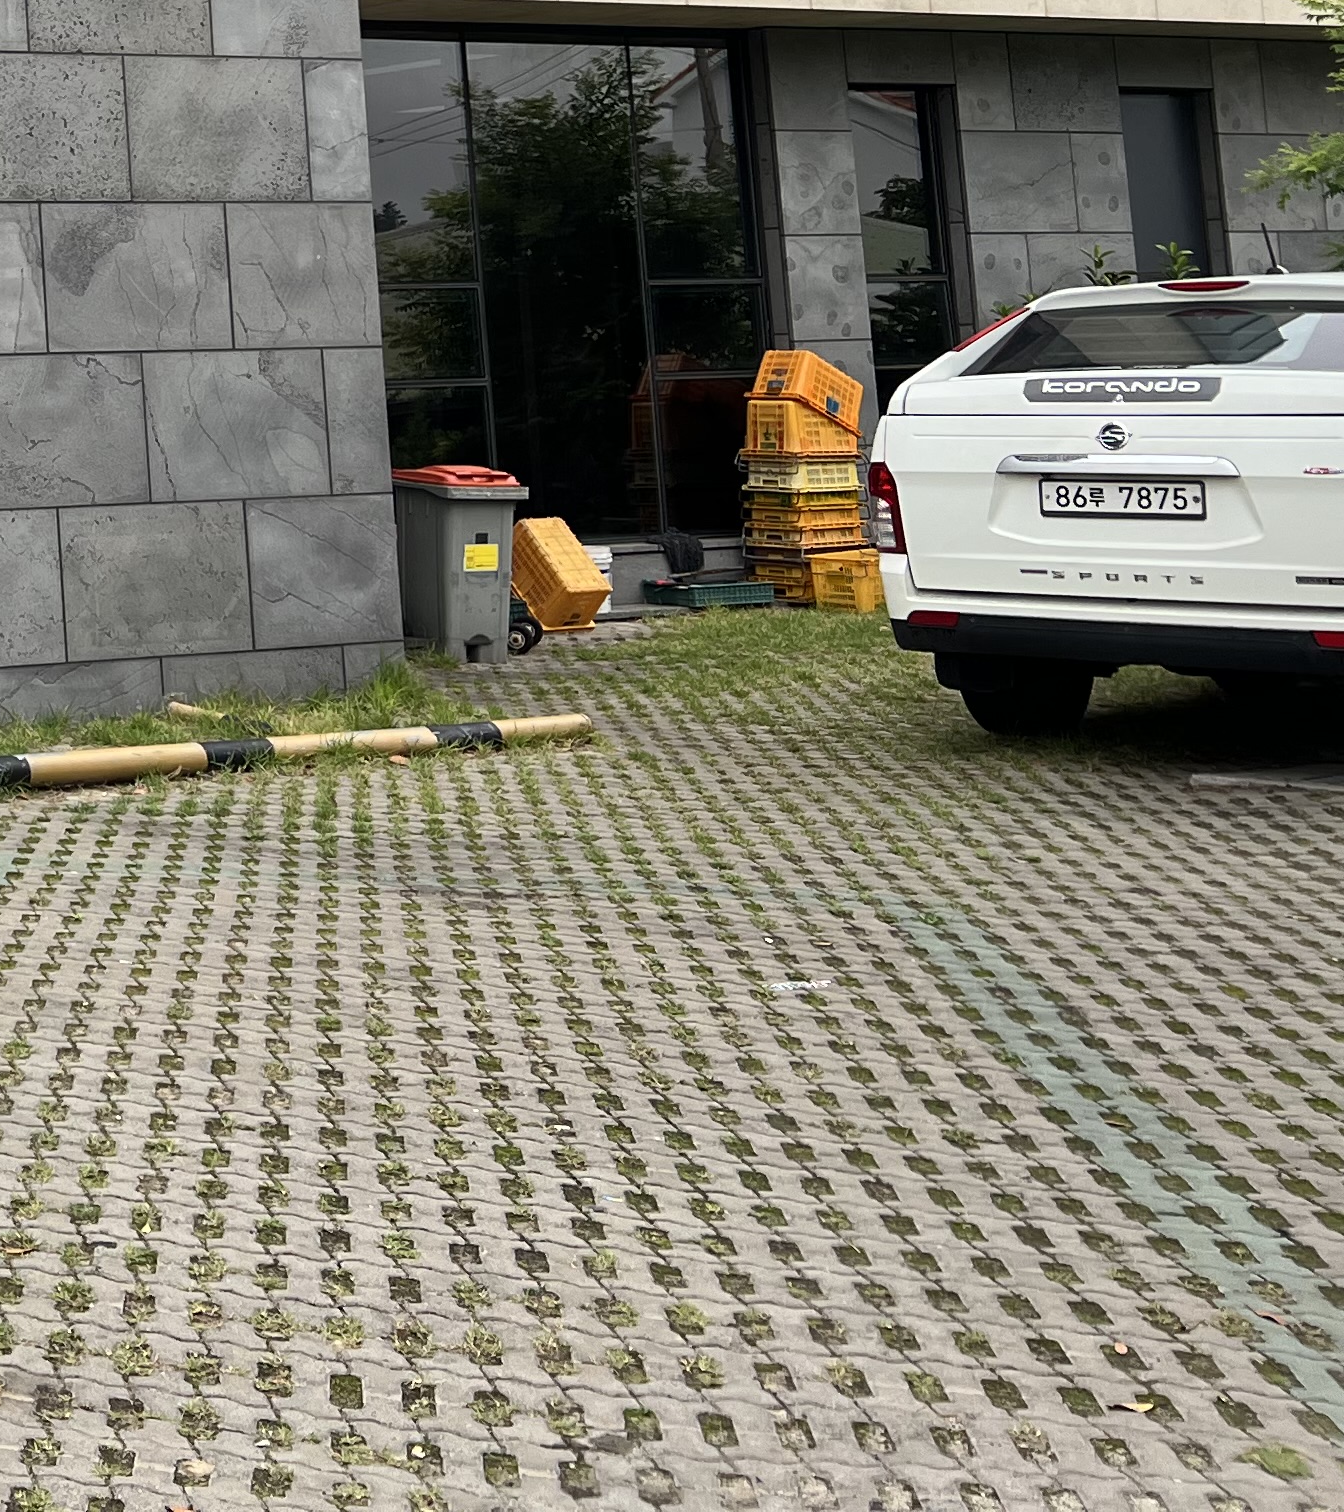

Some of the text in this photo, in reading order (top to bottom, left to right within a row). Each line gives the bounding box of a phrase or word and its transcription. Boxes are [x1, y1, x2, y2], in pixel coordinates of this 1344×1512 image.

[1041, 377, 1201, 393] korando
[1055, 484, 1189, 511] 86루 7875
[1050, 569, 1204, 585] SPORTS
